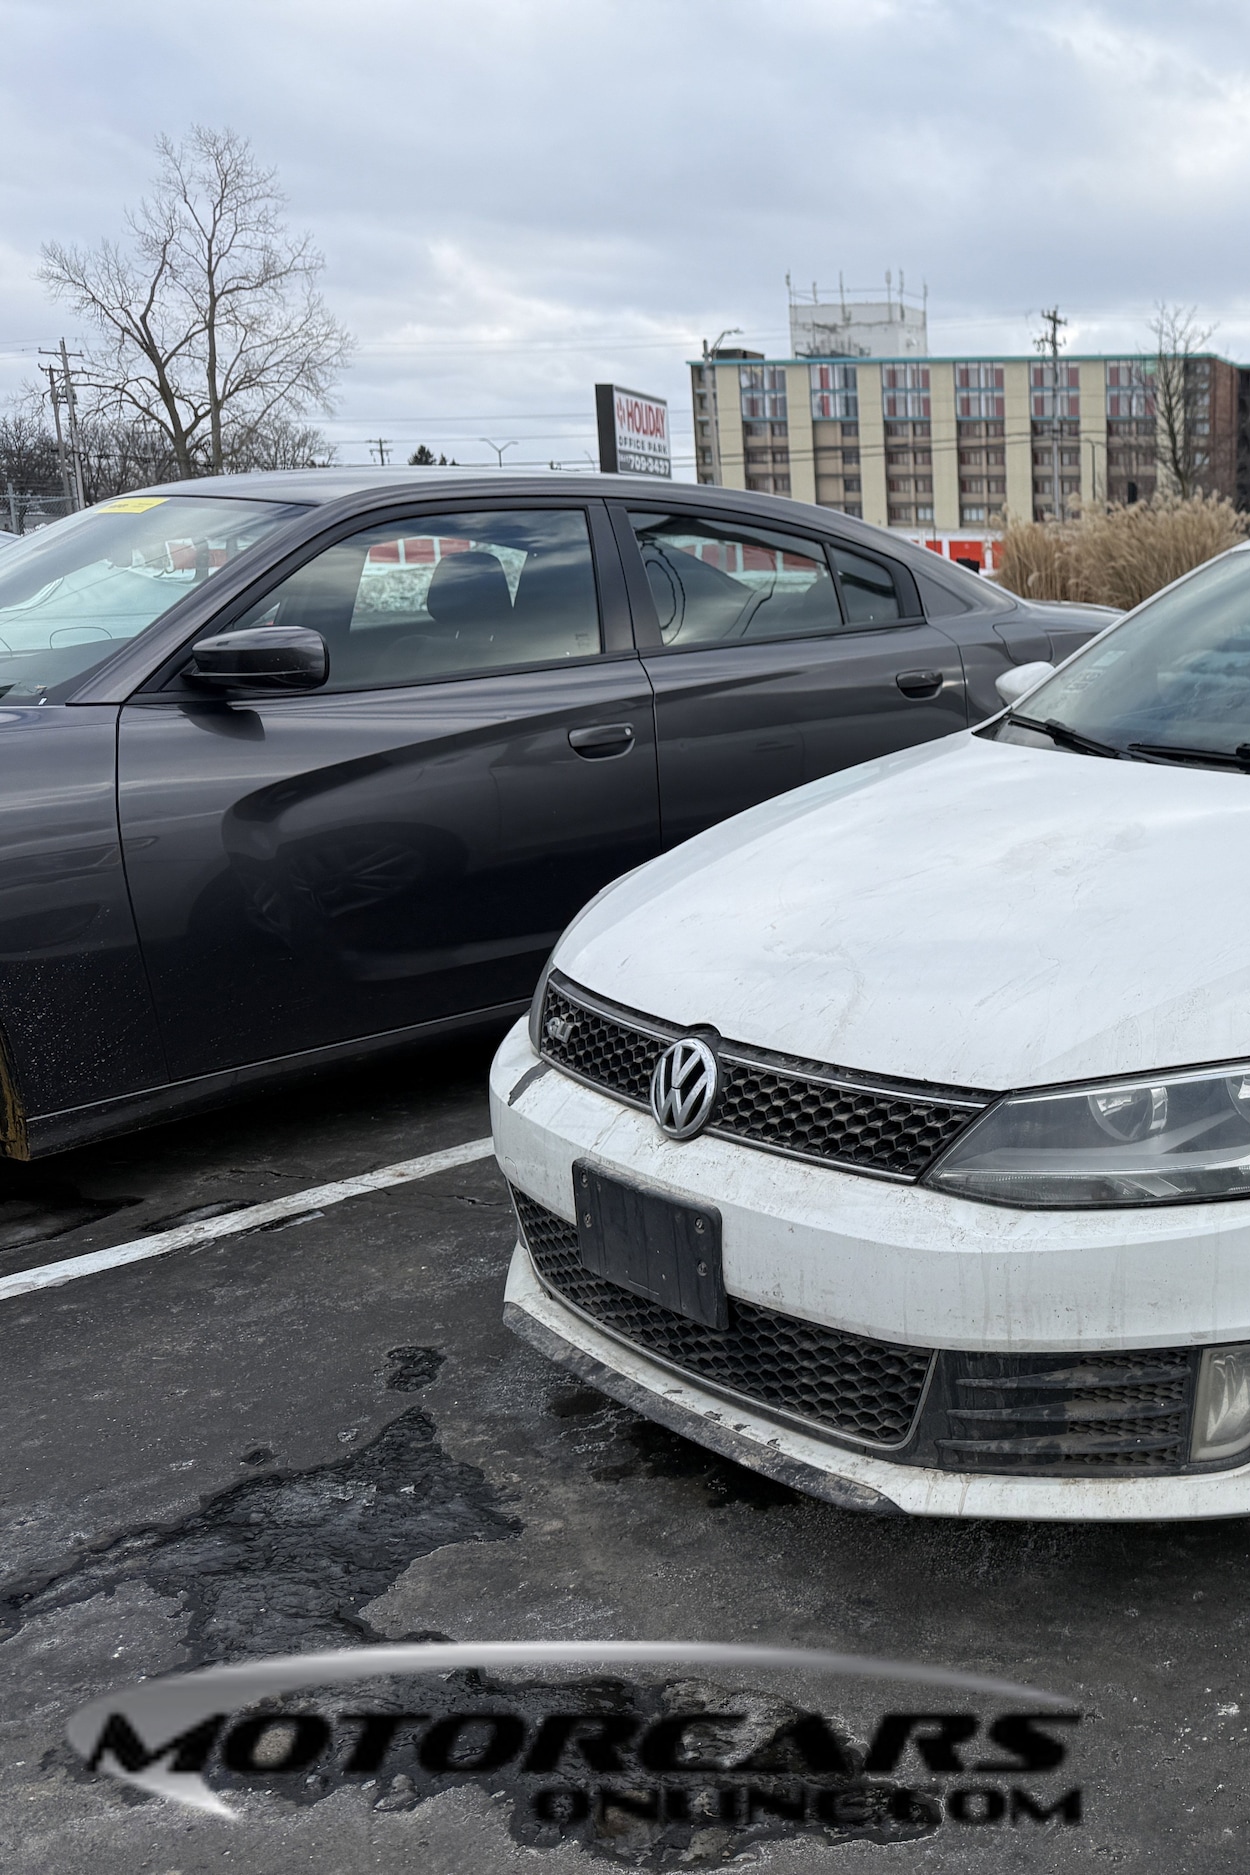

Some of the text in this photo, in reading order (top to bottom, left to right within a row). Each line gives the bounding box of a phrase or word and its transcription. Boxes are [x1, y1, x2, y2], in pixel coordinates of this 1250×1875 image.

[626, 398, 665, 440] HOLIDAY
[619, 436, 668, 455] OFFICE PARK
[651, 1038, 716, 1139] VW
